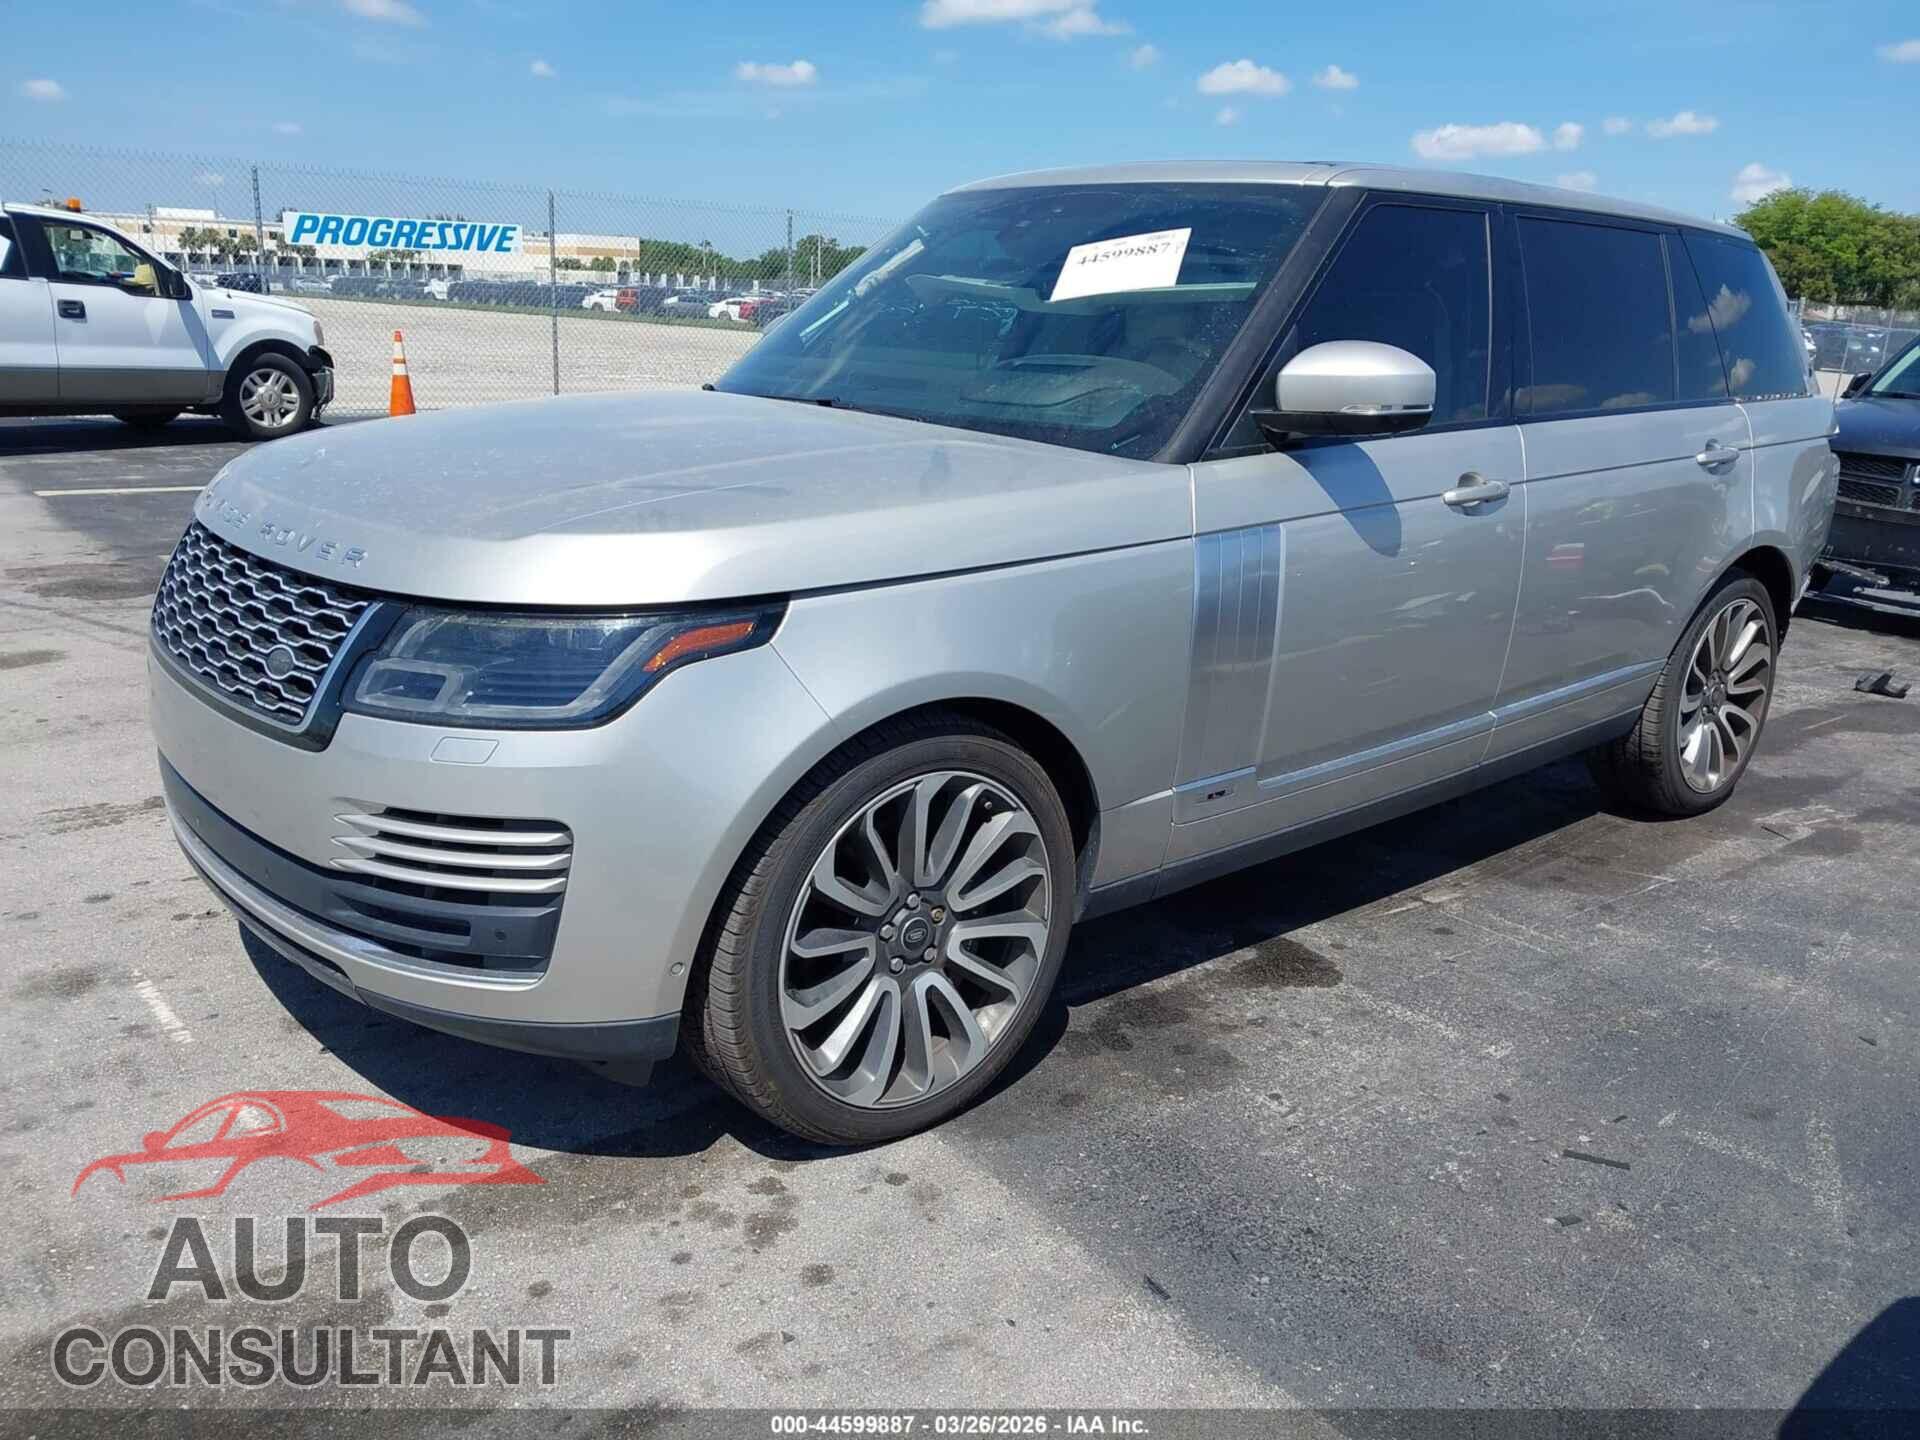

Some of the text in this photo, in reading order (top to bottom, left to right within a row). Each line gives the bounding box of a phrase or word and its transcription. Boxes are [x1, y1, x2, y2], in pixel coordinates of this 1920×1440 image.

[291, 214, 517, 252] PROGRESSIVE
[1077, 242, 1171, 265] 44599887
[259, 520, 368, 568] ROVER
